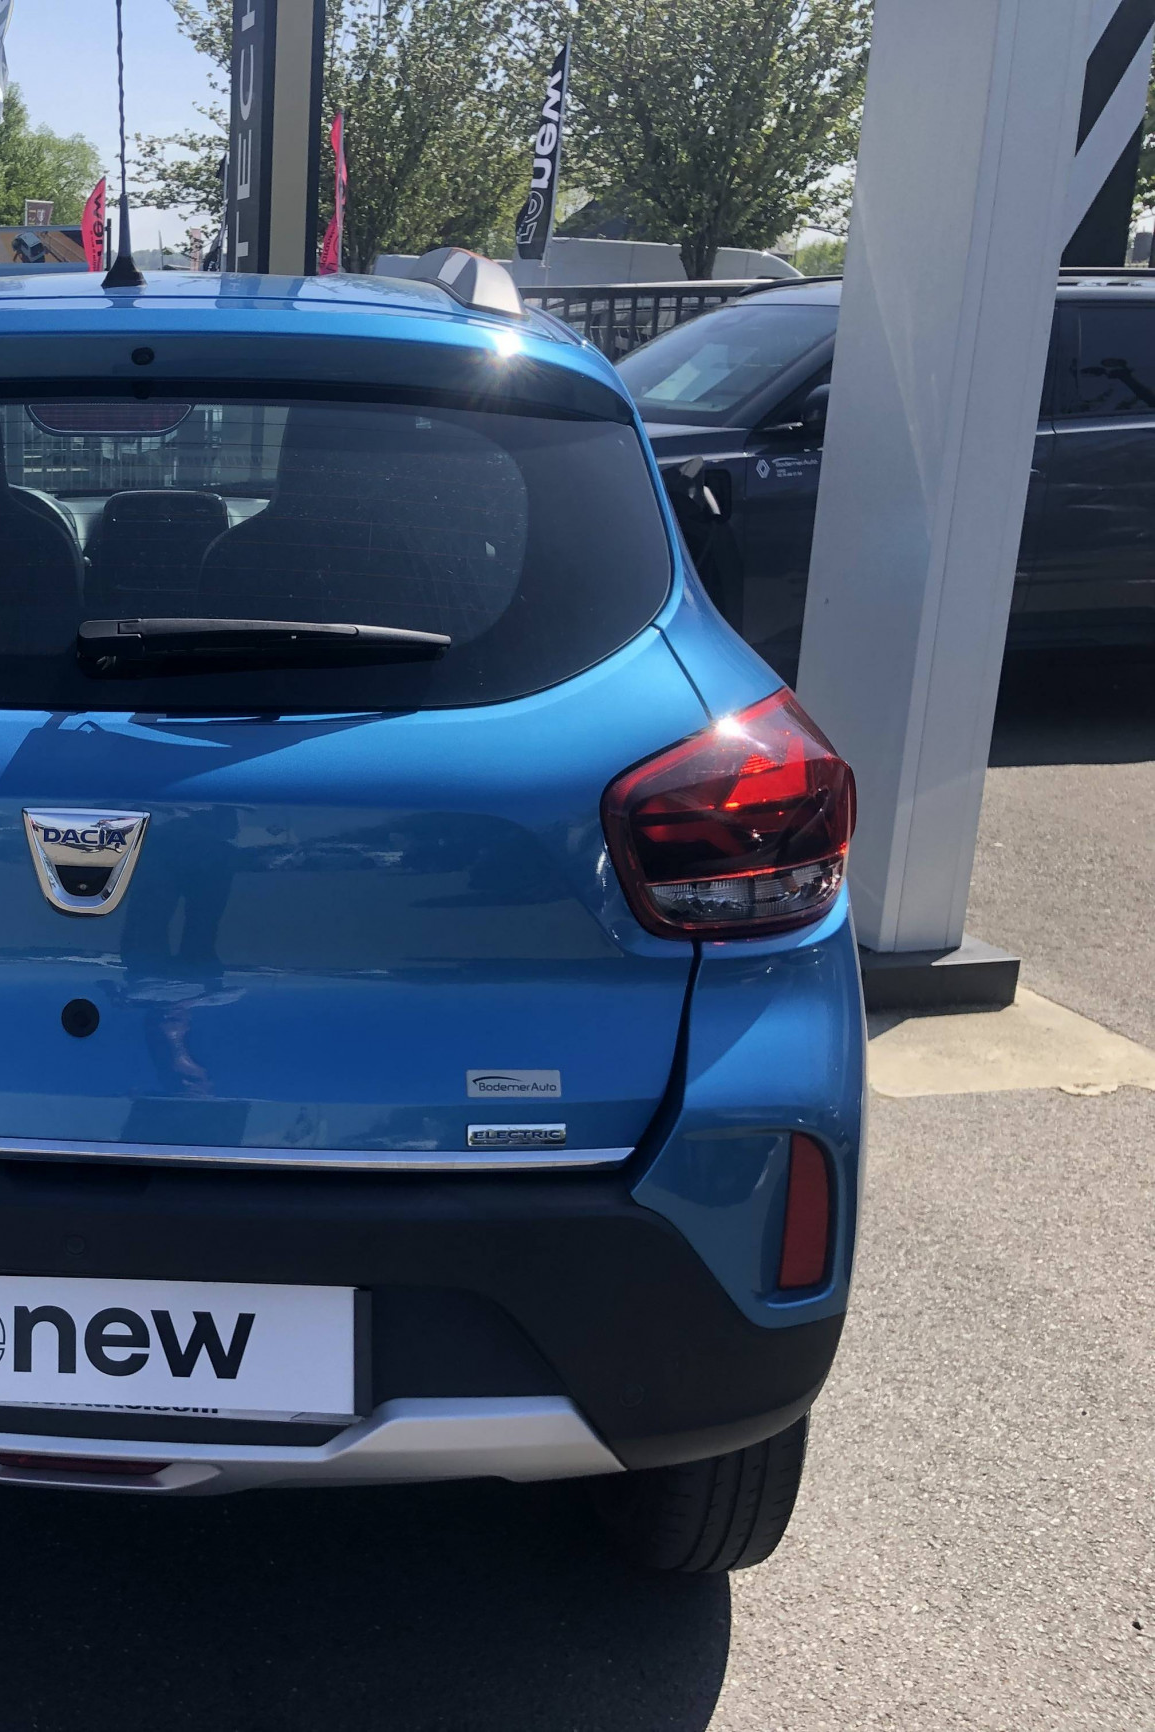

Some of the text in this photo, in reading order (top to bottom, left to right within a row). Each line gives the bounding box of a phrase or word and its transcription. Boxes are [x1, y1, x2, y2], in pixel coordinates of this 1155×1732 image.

[43, 828, 127, 845] DACIA
[478, 1082, 557, 1092] BodemerAuto
[473, 1131, 562, 1140] ELECTRIC
